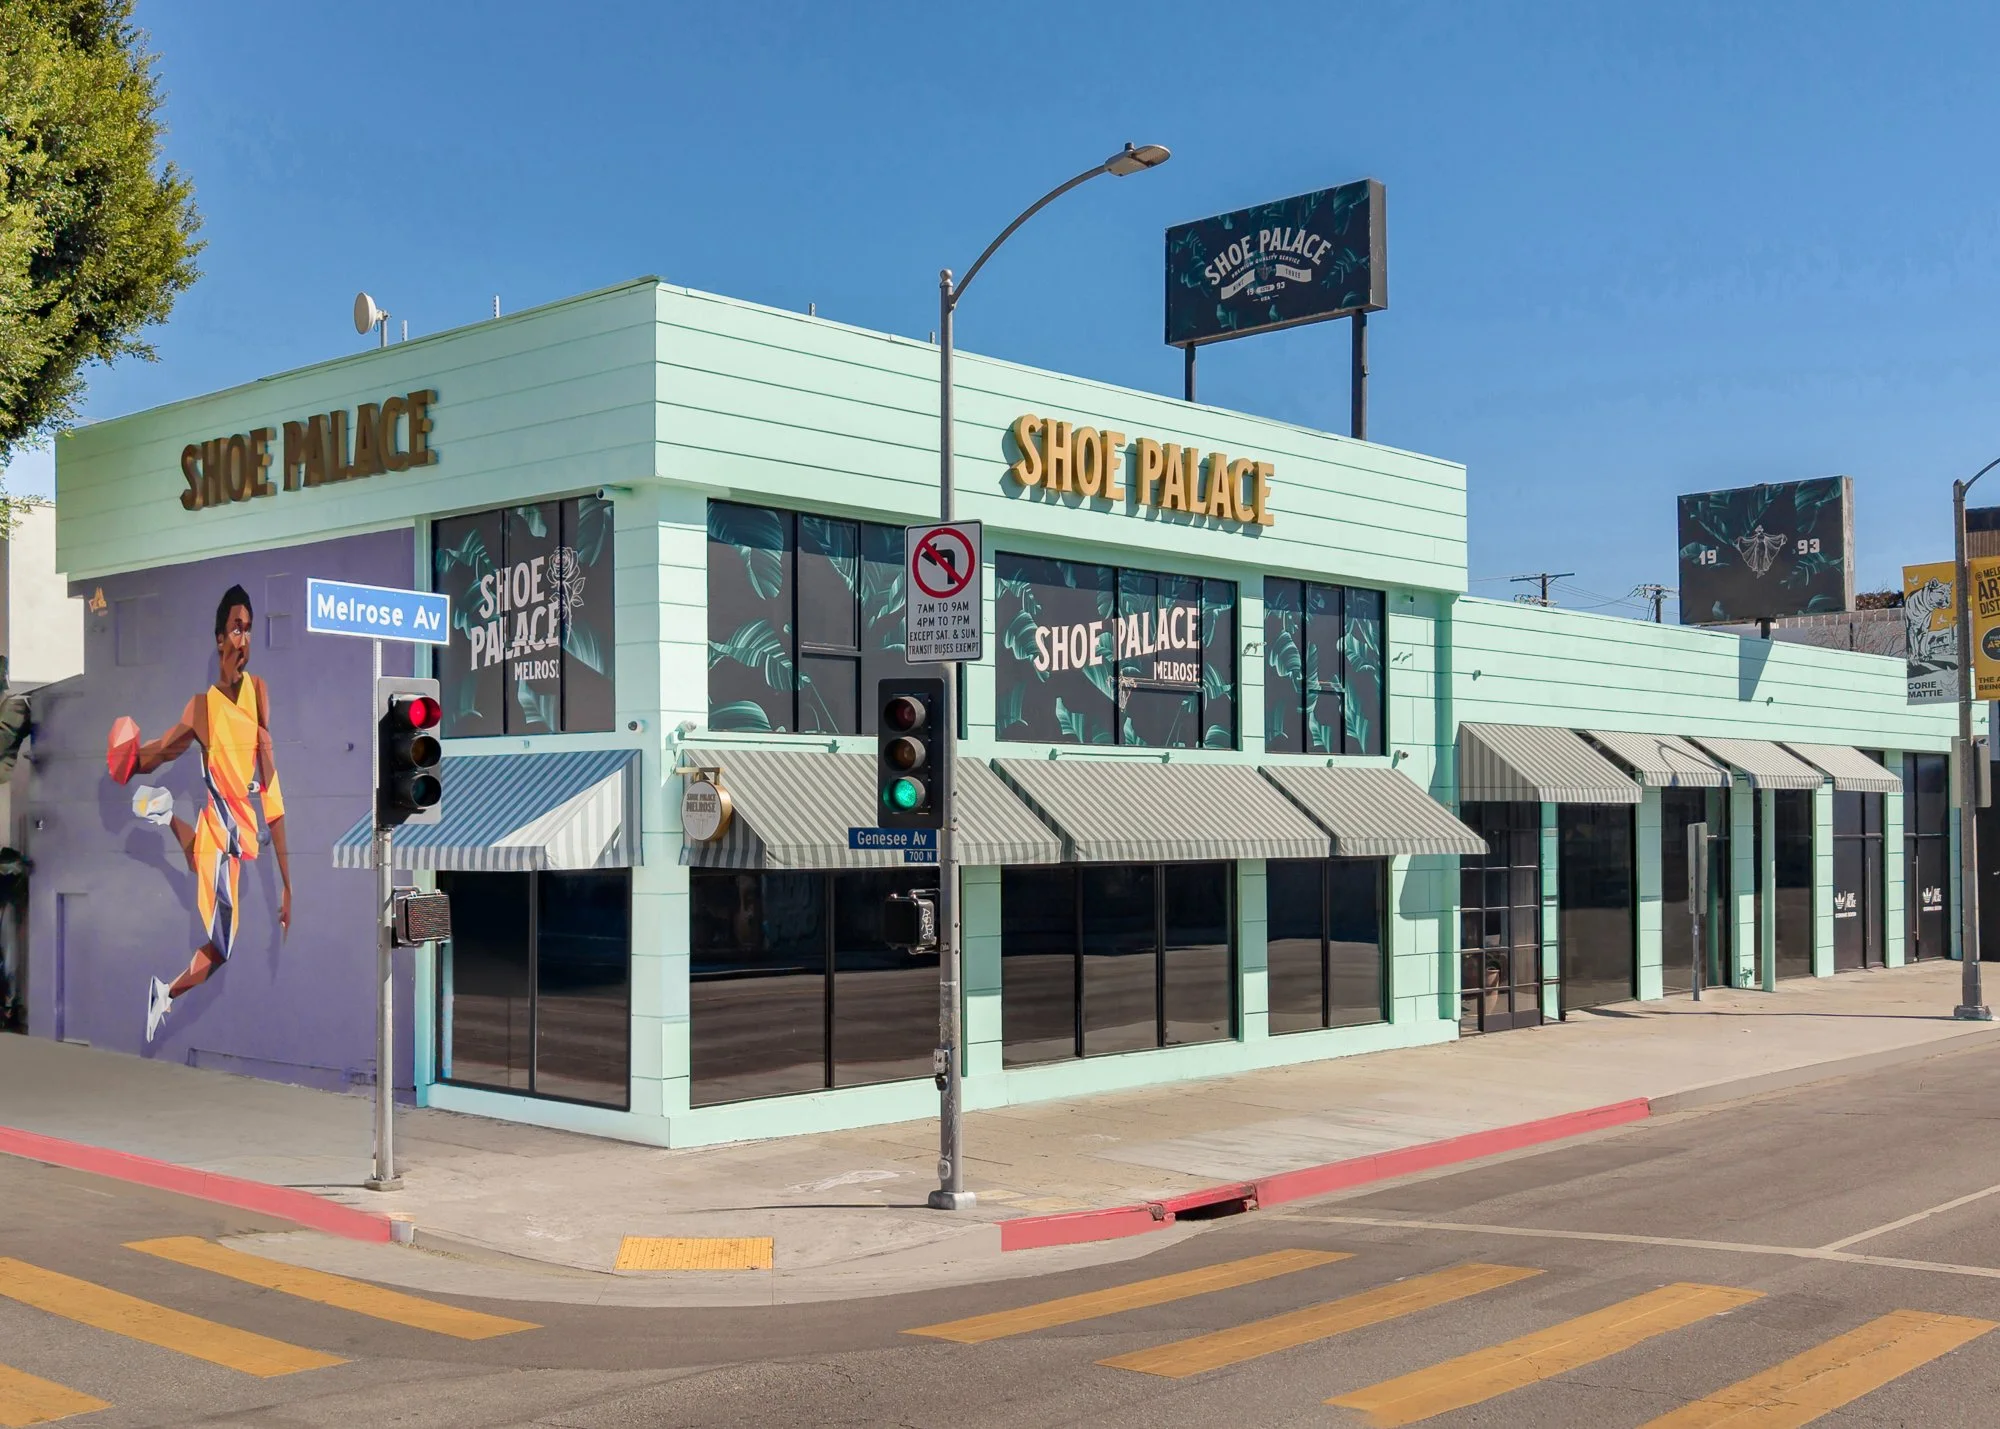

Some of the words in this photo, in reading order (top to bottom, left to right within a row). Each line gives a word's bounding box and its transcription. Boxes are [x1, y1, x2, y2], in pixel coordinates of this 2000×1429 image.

[1204, 234, 1254, 285] SHOE
[1260, 227, 1332, 265] PALACE
[180, 427, 278, 511] SHOE
[282, 389, 439, 493] PALACE
[1011, 413, 1126, 502] SHOE
[1135, 437, 1275, 527] PALACE
[1699, 549, 1717, 565] 19
[1797, 538, 1820, 555] 93
[479, 556, 545, 619] SHOE
[1978, 577, 2000, 602] AR
[317, 593, 404, 627] Melrose
[413, 605, 440, 630] Av
[917, 602, 935, 613] 7AM
[938, 602, 948, 612] TO
[951, 601, 969, 612] 9AM
[917, 616, 935, 628] 4PM
[938, 616, 949, 626] TO
[951, 614, 970, 625] 7PM
[470, 601, 560, 671] PALACE
[909, 630, 934, 641] EXCEPT
[952, 628, 959, 639] &
[961, 628, 978, 639] SUN.
[1033, 620, 1103, 672] SHOE
[1112, 607, 1200, 661] PALACE
[909, 644, 933, 655] TRANSIT
[935, 643, 954, 655] BUSES
[955, 642, 979, 653] EXEMPT
[1153, 660, 1200, 682] MELROSE
[1978, 676, 1995, 684] THE
[1908, 680, 1937, 690] CORIE
[1908, 689, 1943, 699] MATTIE
[686, 801, 716, 813] MELROSE
[857, 831, 908, 845] Genesee
[913, 831, 927, 845] Av
[909, 851, 923, 861] 700
[927, 851, 933, 861] N
